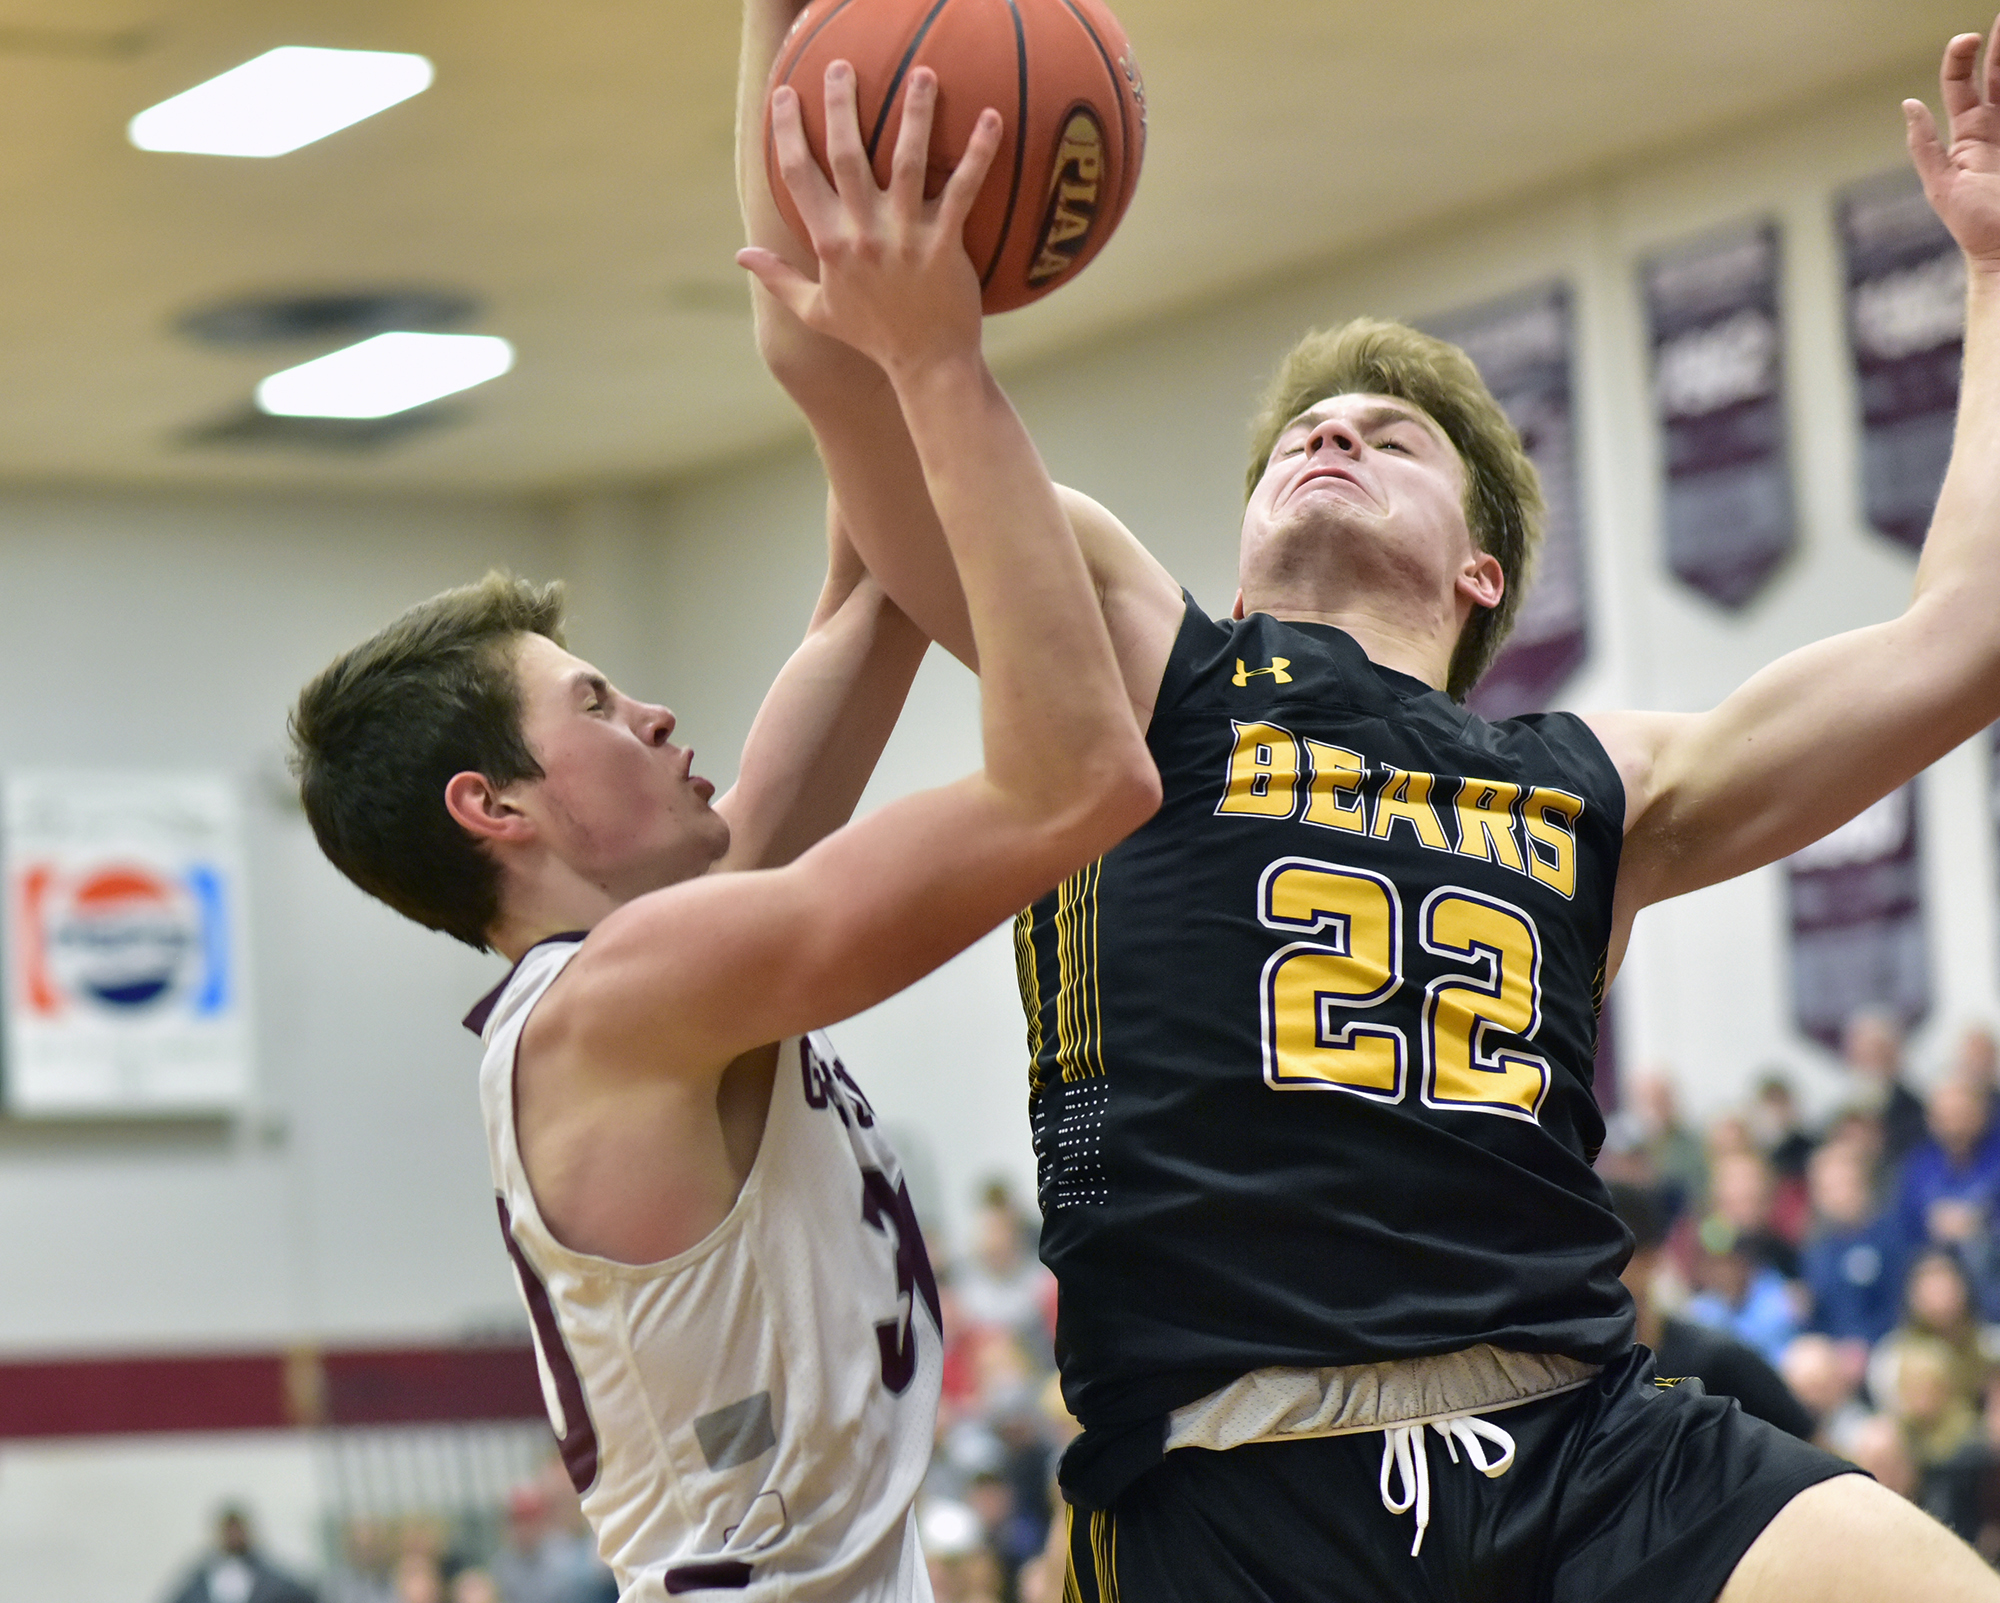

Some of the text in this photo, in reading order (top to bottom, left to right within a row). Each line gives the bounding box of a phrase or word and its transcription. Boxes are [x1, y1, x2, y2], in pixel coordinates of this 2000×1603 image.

[1029, 141, 1099, 281] PIAA
[1213, 718, 1585, 901] BEARS
[1256, 856, 1551, 1126] 22
